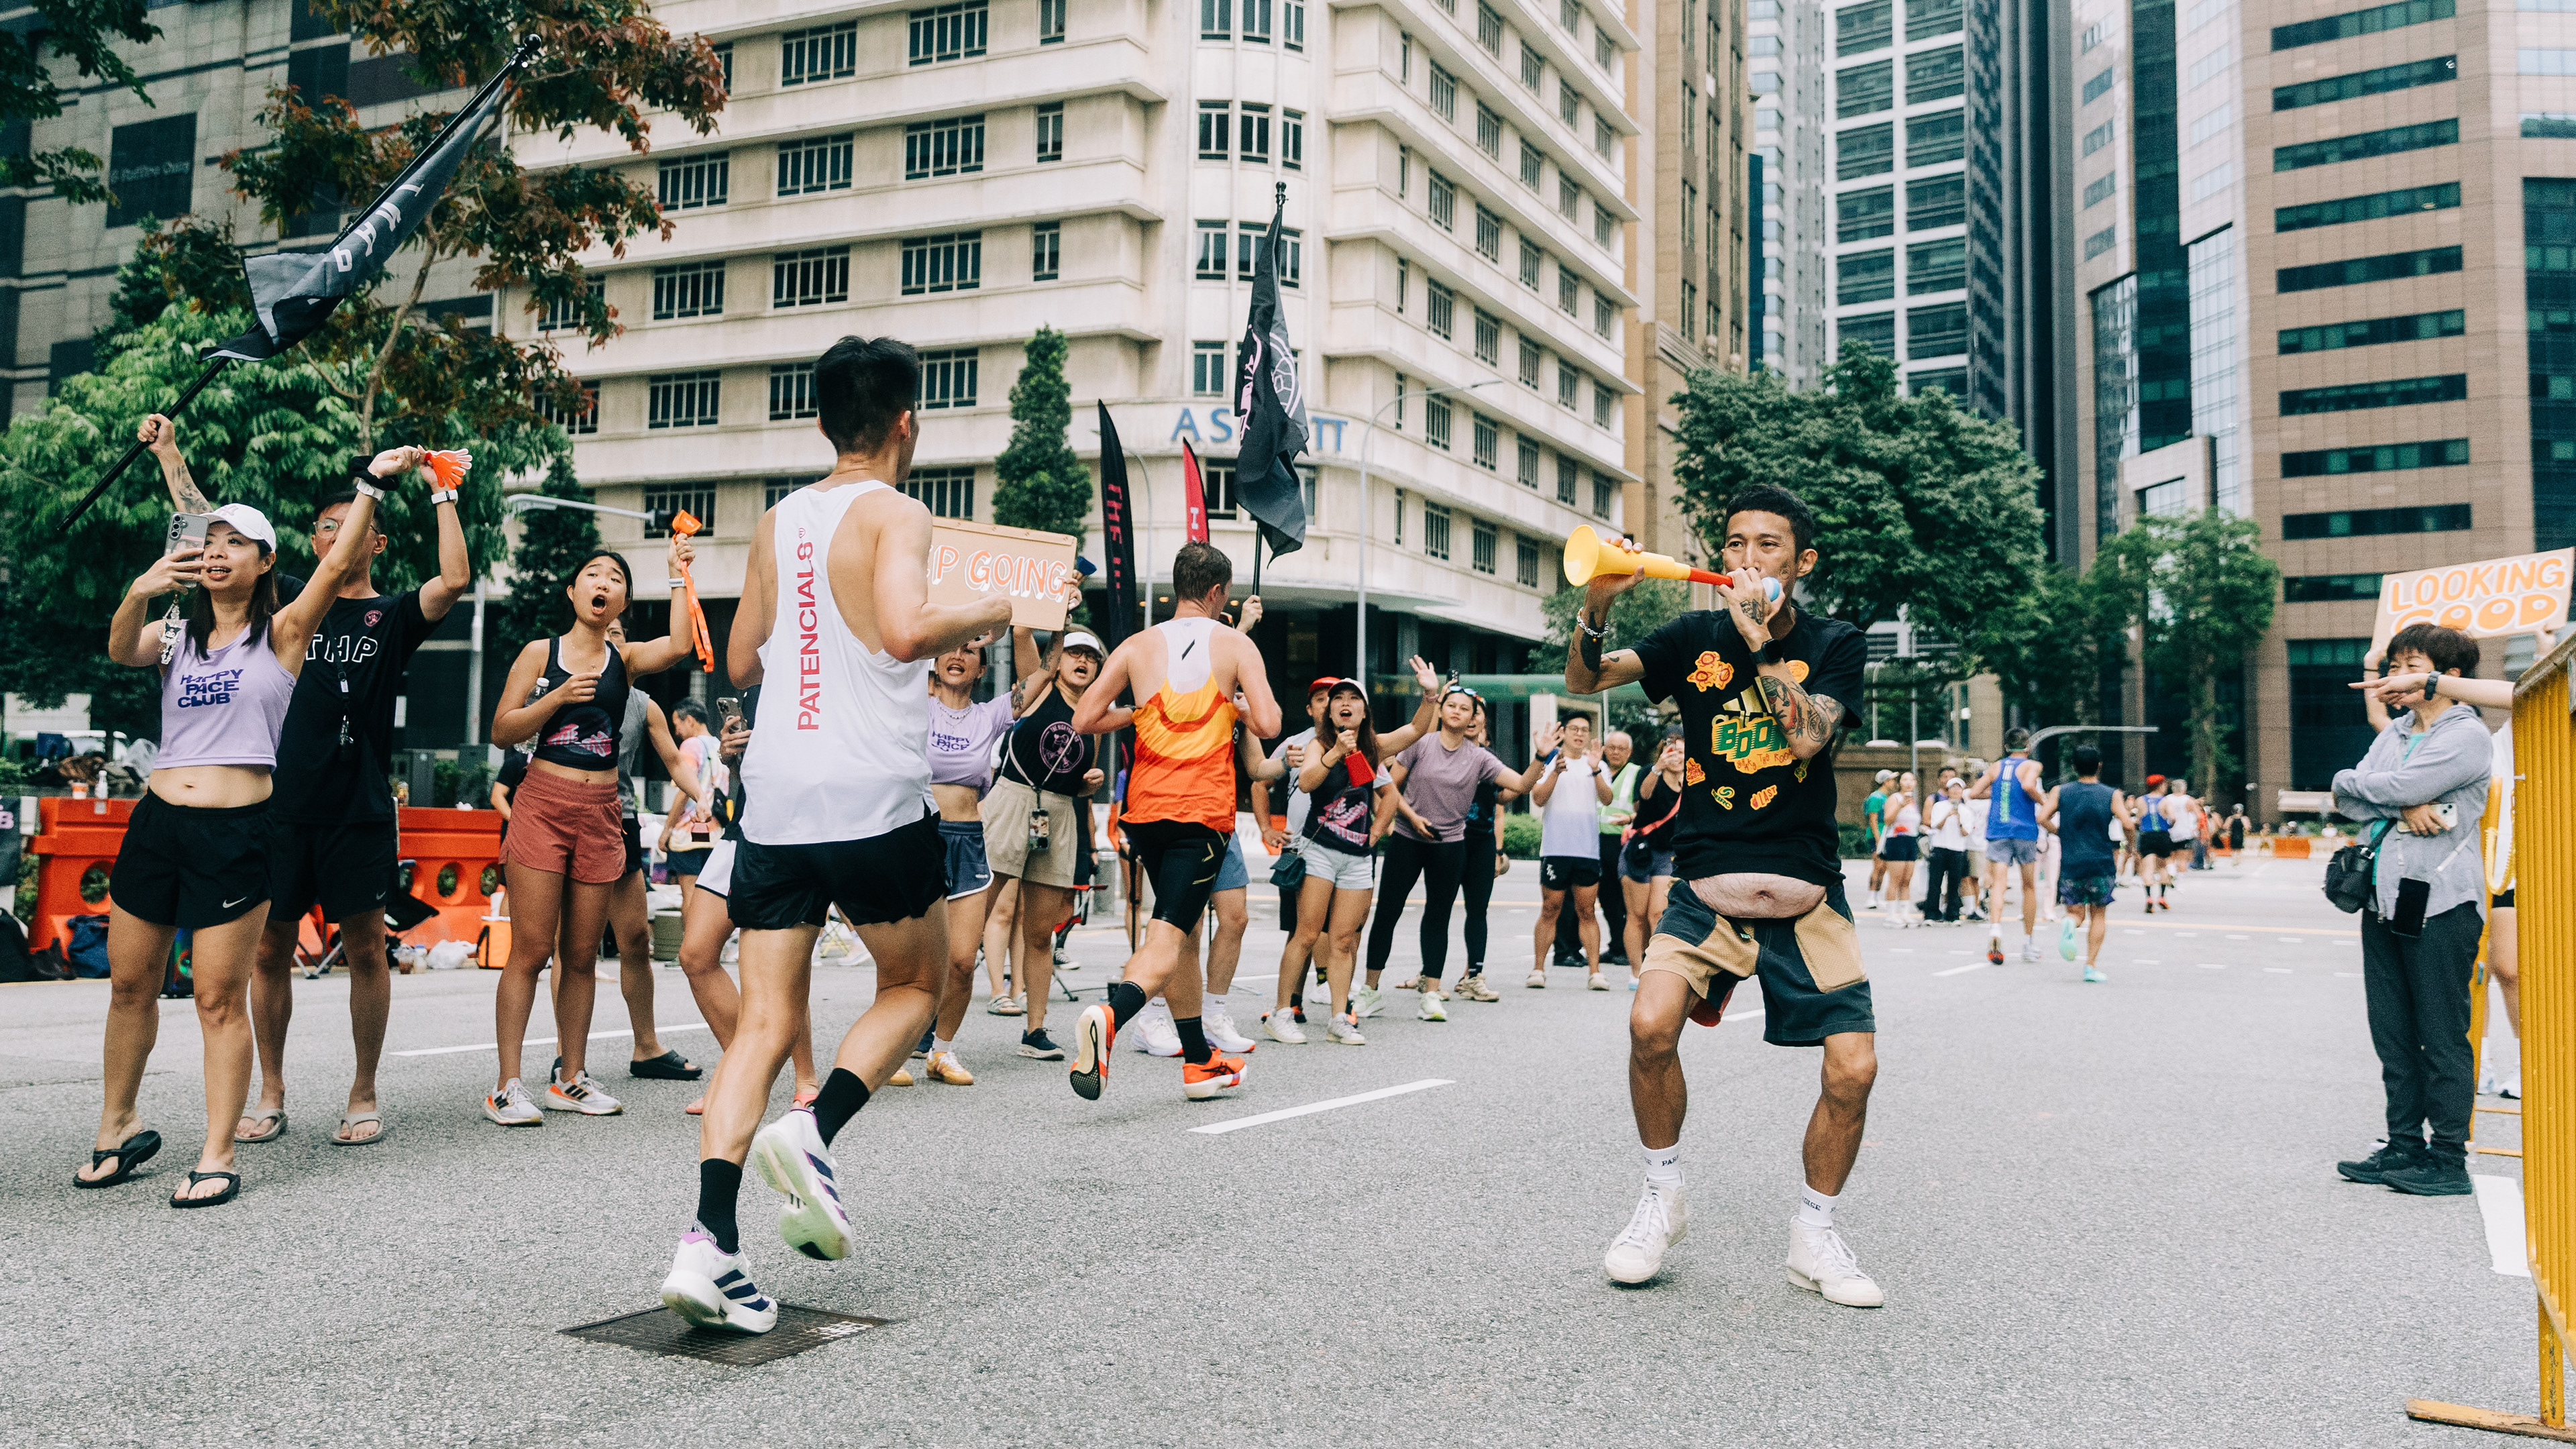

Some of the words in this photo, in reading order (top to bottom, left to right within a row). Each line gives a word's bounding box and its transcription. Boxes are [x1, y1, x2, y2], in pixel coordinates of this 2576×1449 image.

[1170, 407, 1348, 453] ASTT
[964, 549, 1068, 604] GOING
[2388, 557, 2567, 614] LOOKING
[797, 541, 820, 731] PATENCIALS
[177, 692, 231, 708] CLUB
[185, 680, 240, 696] PACE
